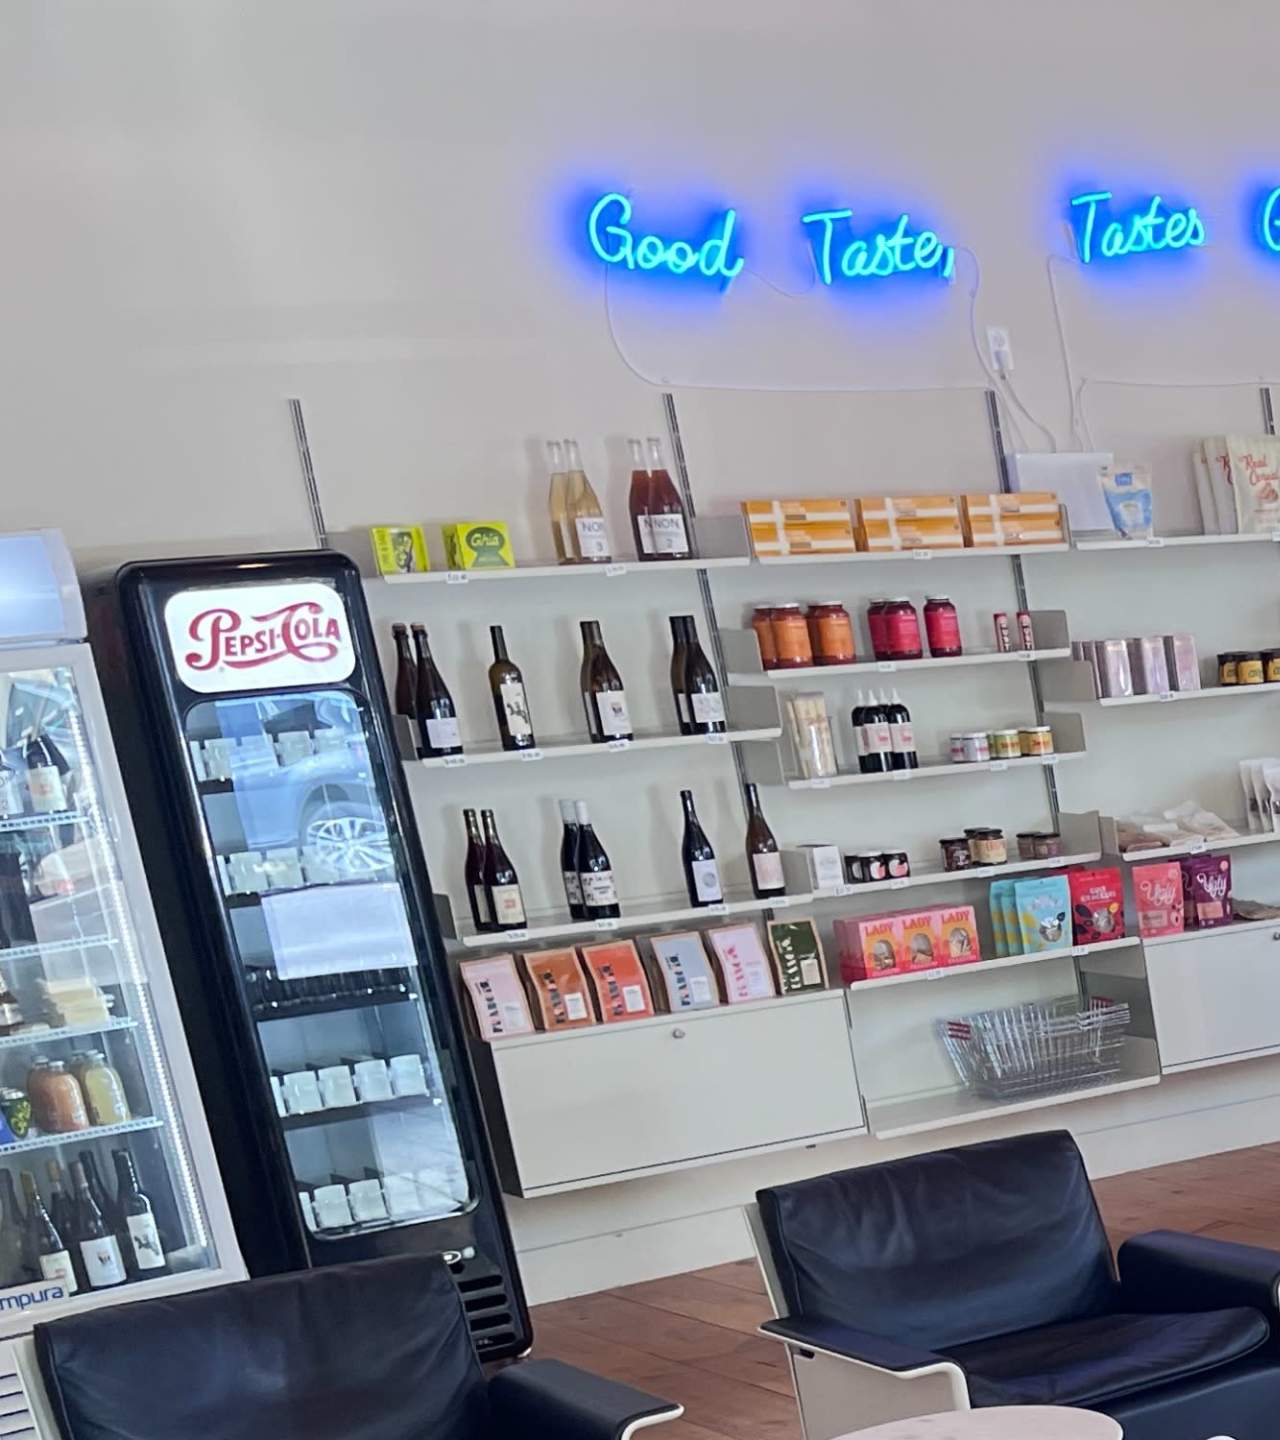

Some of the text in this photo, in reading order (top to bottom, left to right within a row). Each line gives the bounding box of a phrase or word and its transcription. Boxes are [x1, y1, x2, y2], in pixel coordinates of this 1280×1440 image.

[588, 192, 744, 280] Good
[1071, 190, 1205, 264] Tastes
[0, 1285, 65, 1311] mpura
